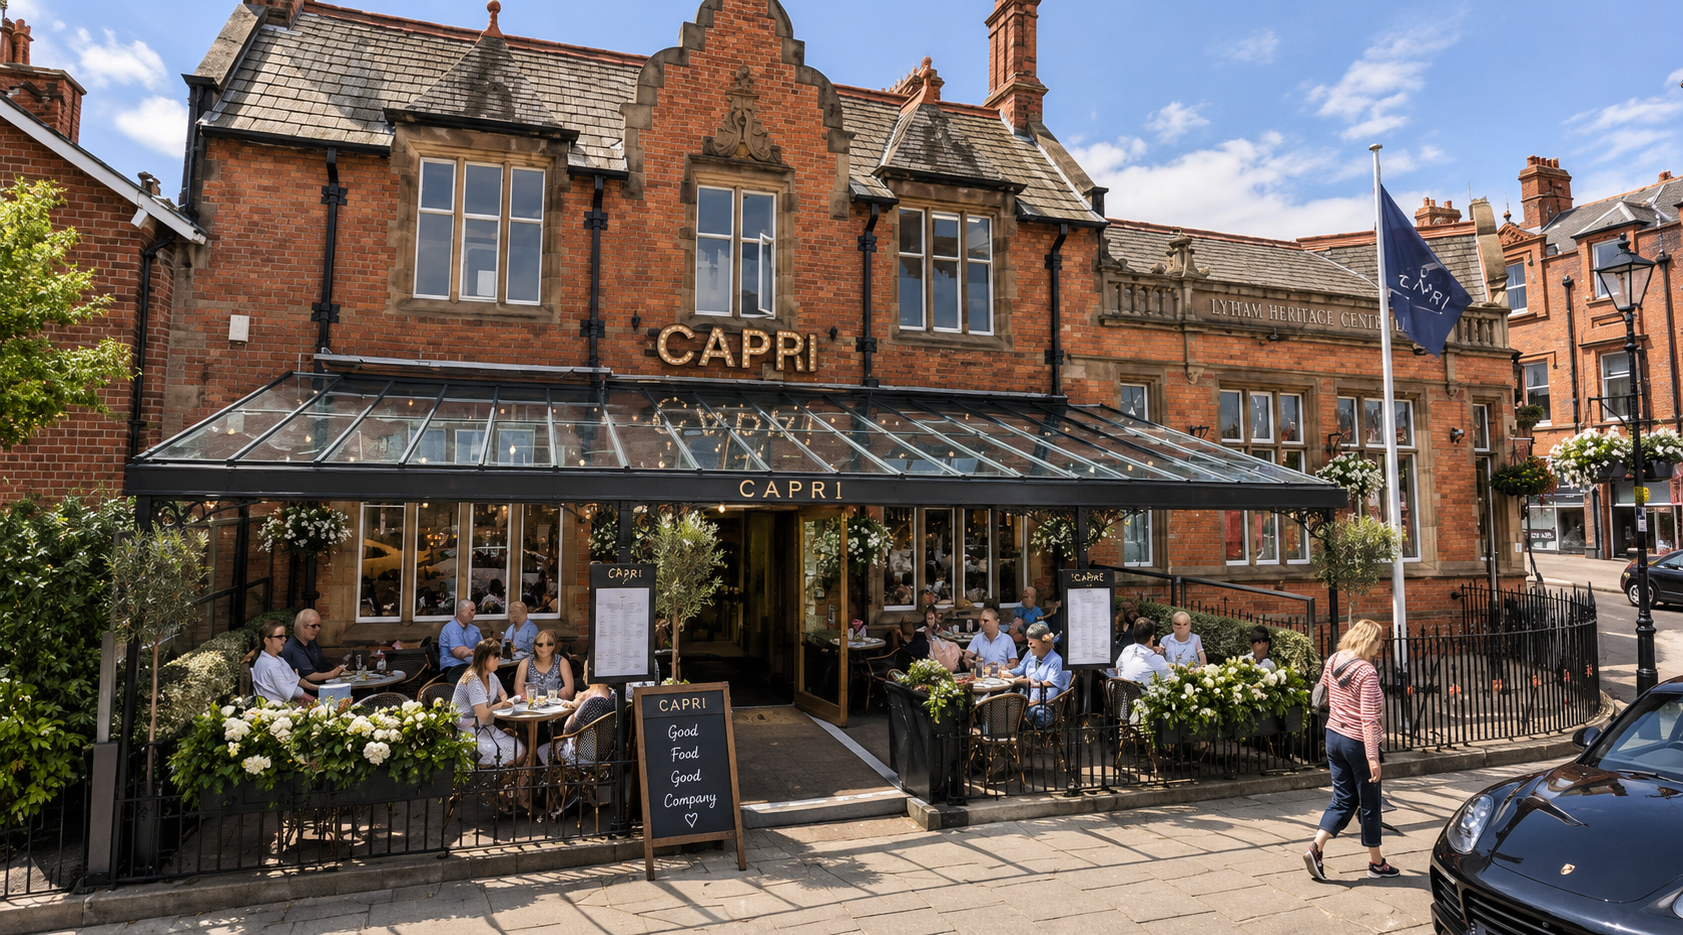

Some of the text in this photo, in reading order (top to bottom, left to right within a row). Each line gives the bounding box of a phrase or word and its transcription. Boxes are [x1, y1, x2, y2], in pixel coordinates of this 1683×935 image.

[1211, 298, 1263, 319] LYTHAM
[1268, 304, 1335, 326] HERITAGE
[657, 323, 818, 372] CAPRI
[739, 479, 842, 500] CAPRI
[608, 567, 642, 580] CAPRI
[659, 697, 706, 712] CAPRI
[668, 723, 699, 741] Good
[671, 746, 700, 762] Food
[671, 768, 702, 787] Good
[664, 793, 717, 809] Company
